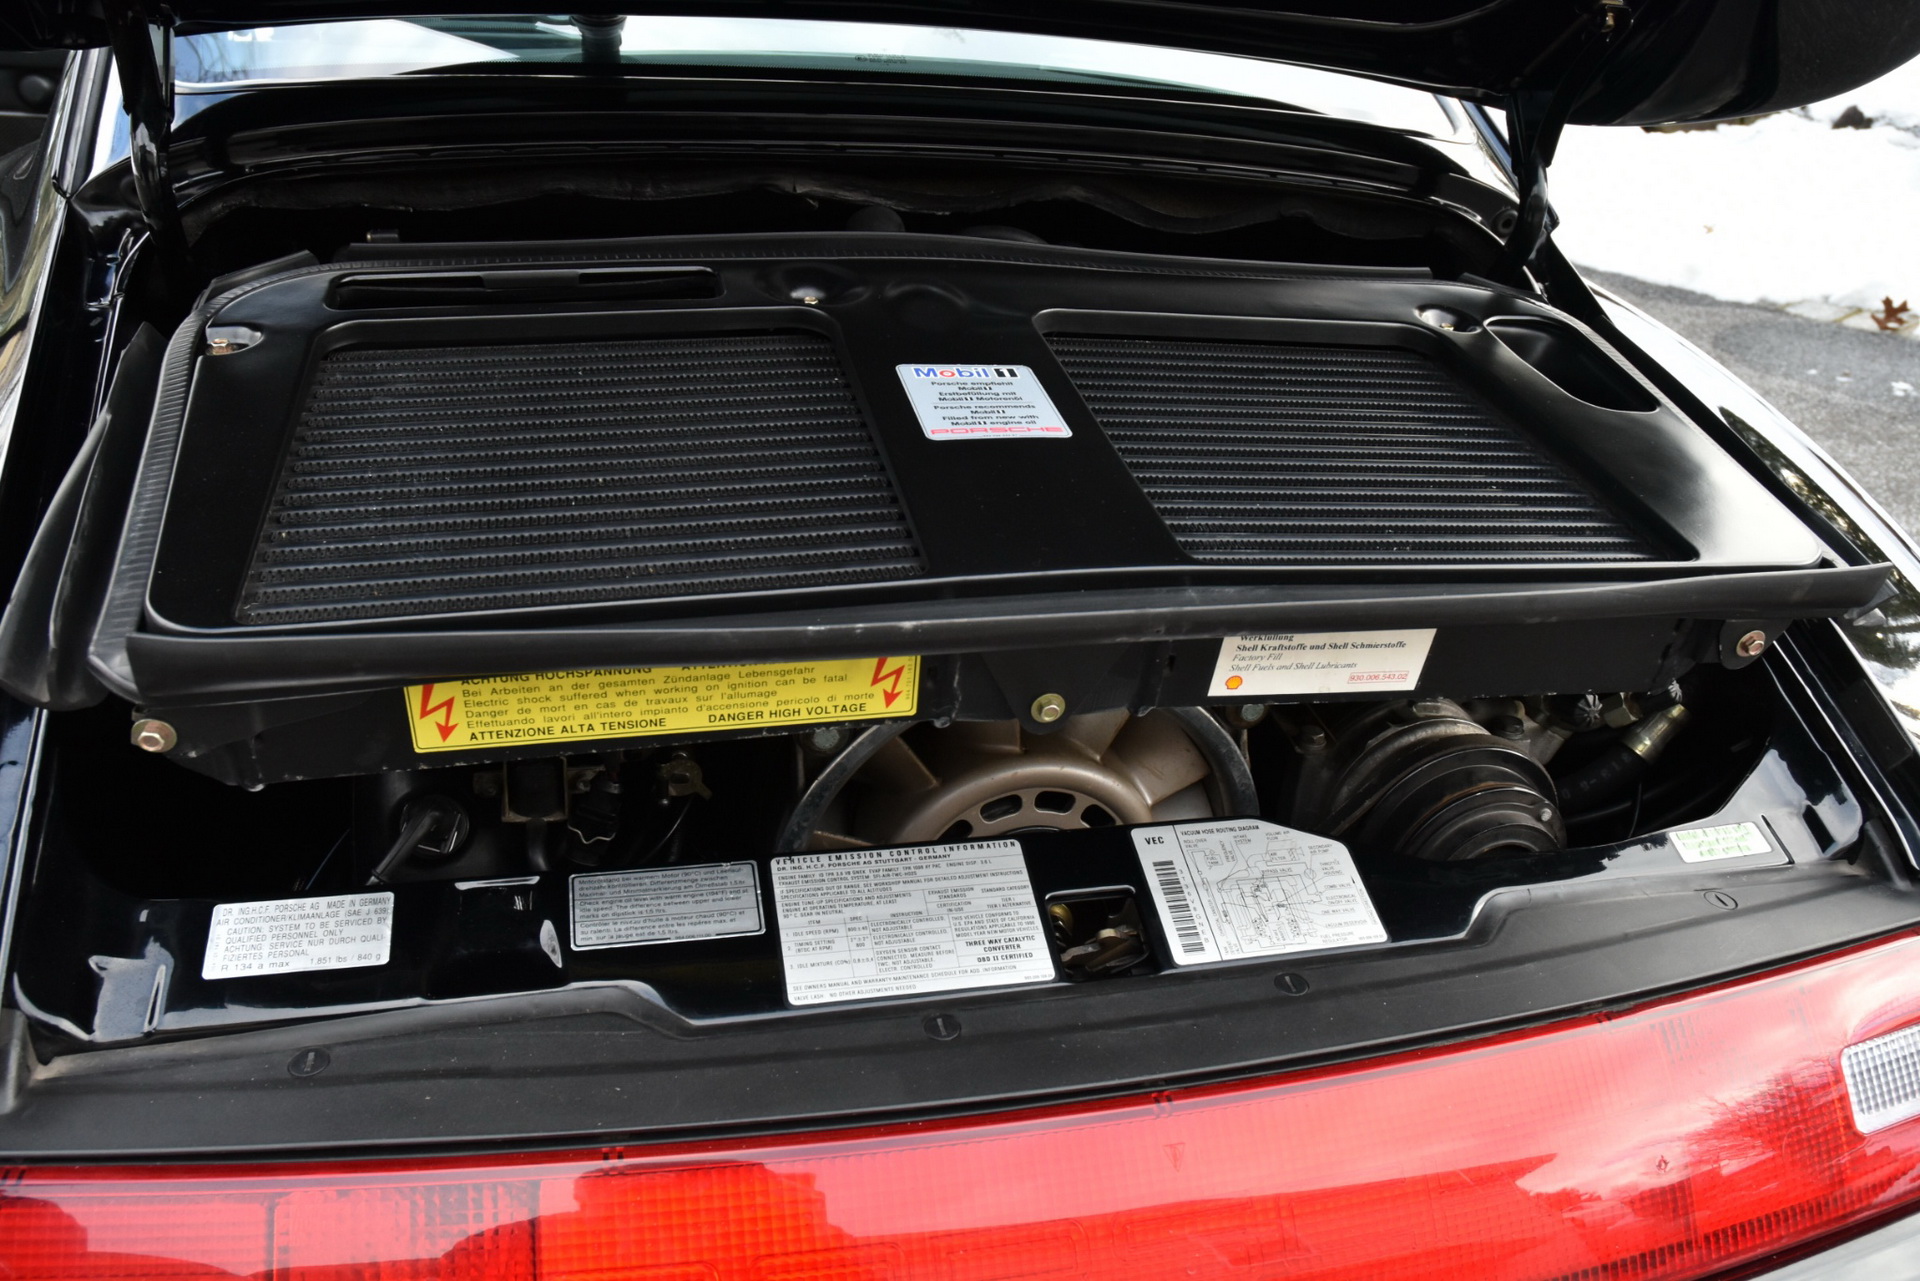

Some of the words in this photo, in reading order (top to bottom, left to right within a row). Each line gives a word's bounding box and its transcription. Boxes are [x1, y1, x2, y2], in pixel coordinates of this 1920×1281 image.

[913, 368, 990, 378] Mobil
[993, 368, 1018, 378] 1
[1260, 643, 1307, 651] Kraftstoffe
[1350, 641, 1406, 649] Schmierstoffe
[461, 674, 530, 686] ACHTUNG
[535, 668, 652, 680] HOCHSPANNUNG
[462, 689, 482, 698] Bei
[490, 685, 540, 696] Arbeiten
[571, 682, 590, 690] der
[598, 678, 655, 689] gesamten
[663, 674, 730, 684] Zündanlage
[738, 667, 815, 678] Lebensgefahr
[464, 698, 509, 708] Electric
[517, 695, 552, 704] shock
[560, 692, 608, 701] suffered
[616, 689, 646, 697] when
[654, 686, 698, 694] working
[727, 680, 768, 690] ignition
[775, 678, 795, 686] can
[466, 709, 508, 718] Danger
[540, 704, 566, 713] mort
[574, 702, 588, 710] en
[646, 697, 688, 705] travaux
[721, 690, 777, 700] l'allumage
[467, 717, 535, 729] Effettuando
[543, 714, 575, 723] lavori
[584, 710, 632, 720] all'intero
[641, 706, 688, 716] impianto
[696, 700, 768, 712] d'accensione
[777, 696, 820, 707] pericolo
[708, 711, 763, 723] DANGER
[770, 708, 800, 718] HIGH
[806, 703, 866, 716] VOLTAGE
[470, 726, 554, 741] ATTENZIONE
[561, 723, 595, 734] ALTA
[600, 718, 666, 731] TENSIONE
[1145, 836, 1164, 845] VEC
[776, 856, 820, 865] VEHICLE
[828, 852, 882, 861] EMISSION
[890, 848, 937, 857] CONTROL
[944, 841, 1015, 852] INFORMATION
[274, 903, 306, 912] PORSCHE
[327, 900, 345, 909] MADE
[360, 897, 391, 906] GERMANY
[345, 909, 362, 917] (SAE
[269, 924, 300, 932] SYSTEM
[335, 918, 372, 928] SERVICED
[226, 935, 266, 944] QUALIFIED
[271, 931, 317, 940] PERSONNEL
[269, 940, 302, 950] SERVICE
[329, 937, 356, 945] DURCH
[984, 944, 1021, 952] CONVERTER
[223, 952, 263, 962] FIZIERTES
[268, 949, 309, 958] PERSONAL
[1001, 952, 1033, 960] CERTIFIED
